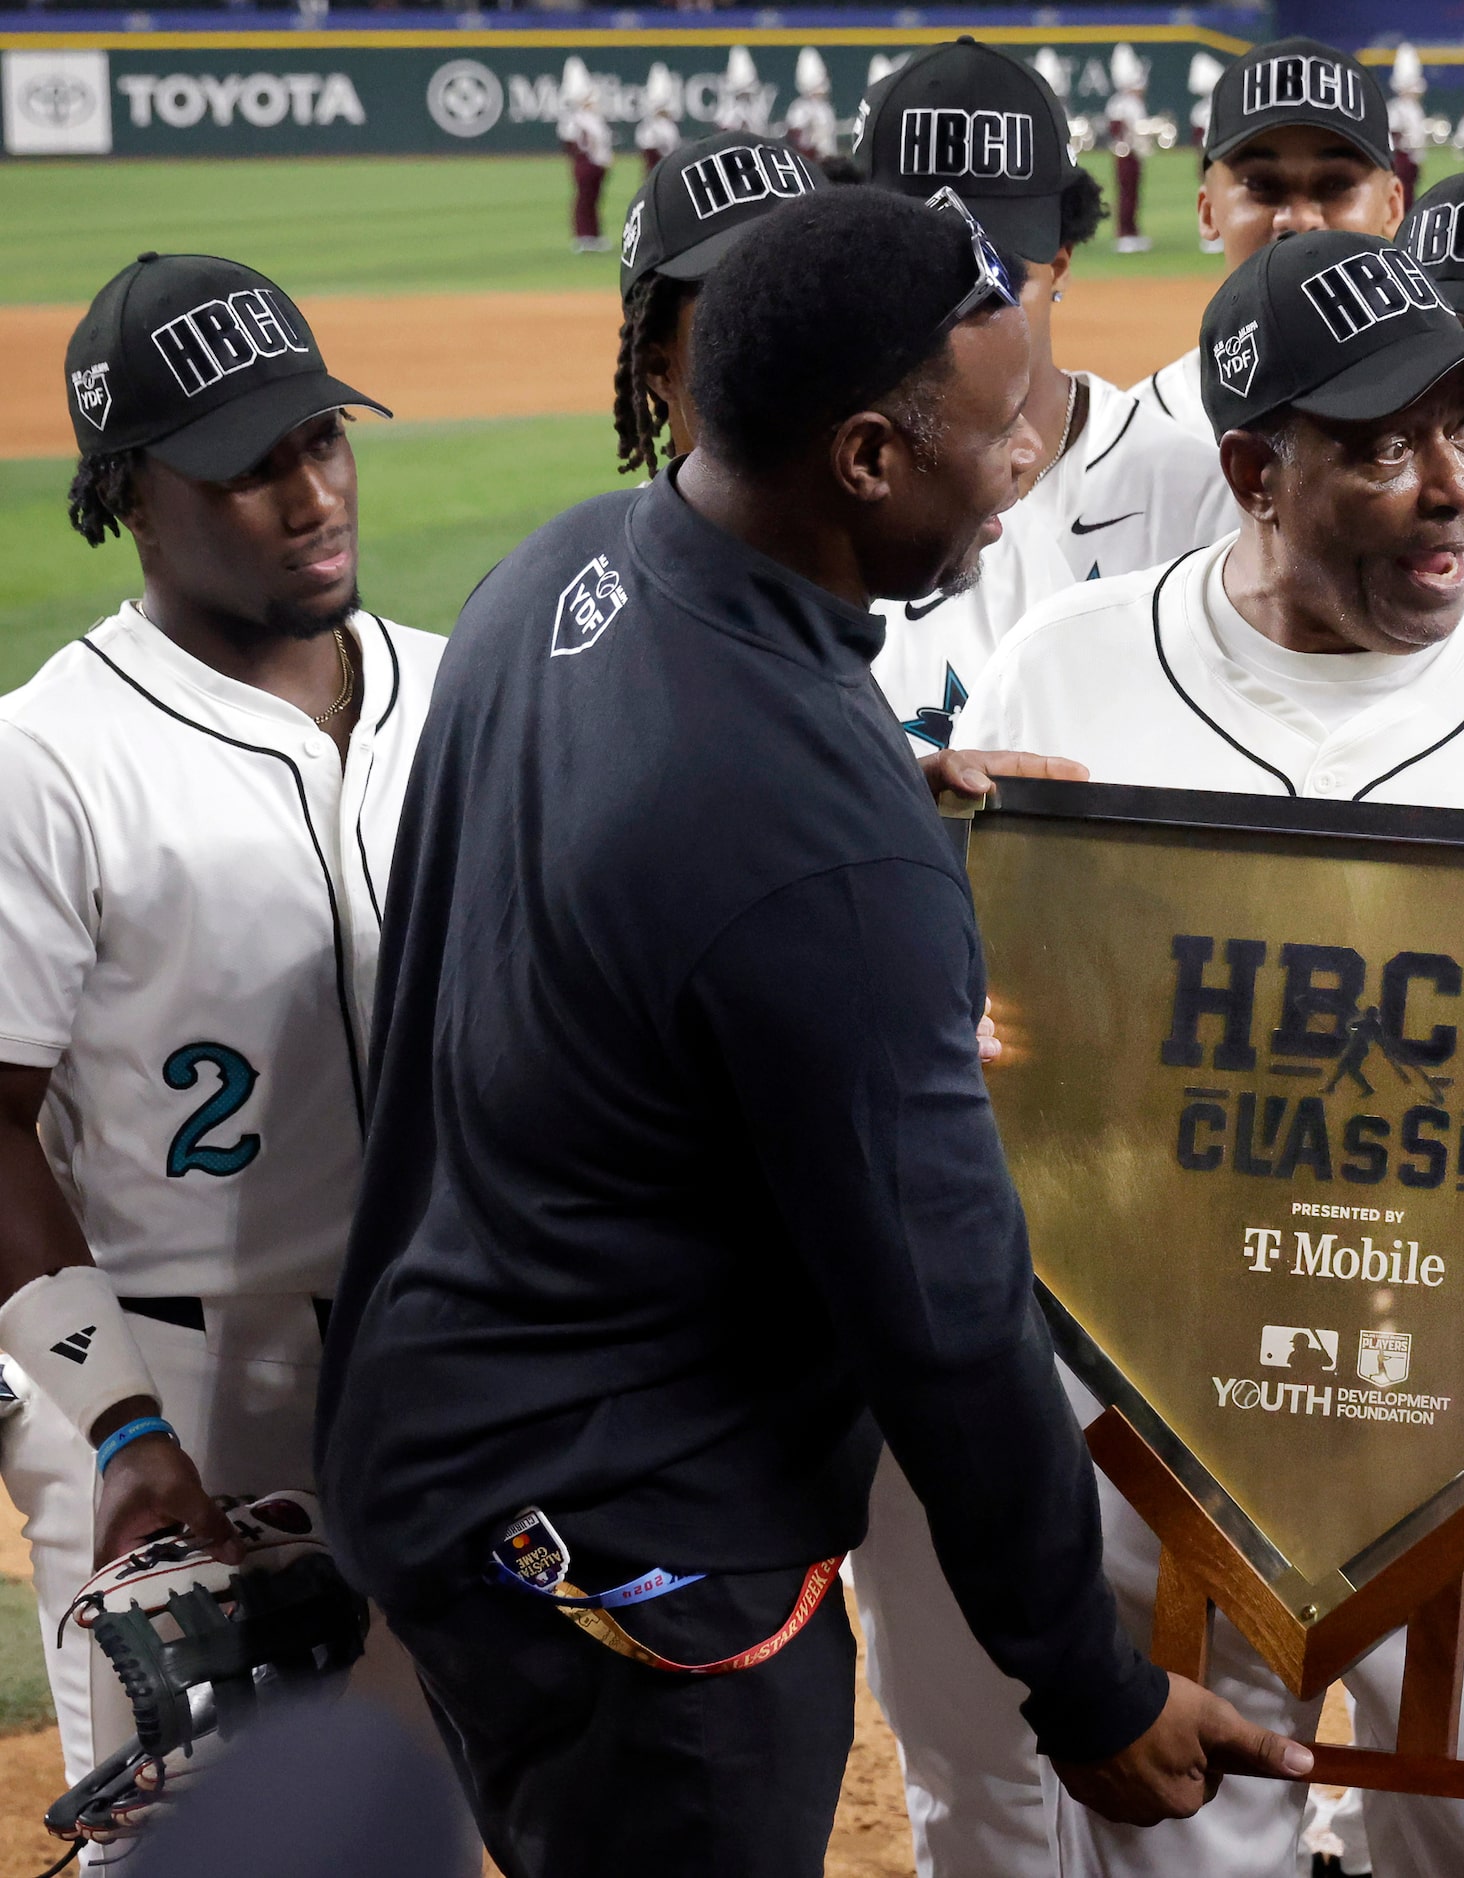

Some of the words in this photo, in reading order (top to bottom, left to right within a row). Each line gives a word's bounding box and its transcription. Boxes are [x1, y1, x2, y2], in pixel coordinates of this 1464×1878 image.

[117, 73, 366, 126] TOYOTA
[1243, 54, 1366, 121] HBCU
[901, 107, 1034, 181] HBCU
[681, 144, 816, 220] HBC
[1301, 248, 1457, 343] HBC
[1222, 348, 1252, 379] YDF
[81, 387, 104, 410] YDF
[569, 582, 605, 634] YDF
[161, 1041, 262, 1178] 2
[1291, 1202, 1380, 1222] PRESENTED
[1384, 1209, 1405, 1224] BY
[1290, 1231, 1446, 1288] Mobile
[1362, 1337, 1408, 1352] PLAYERS
[1212, 1376, 1332, 1417] YOUTH
[1336, 1403, 1435, 1425] FOUNDATION
[1337, 1387, 1451, 1411] DEVELOPMENT
[515, 1546, 548, 1570] GAME
[795, 1568, 829, 1626] WEEK
